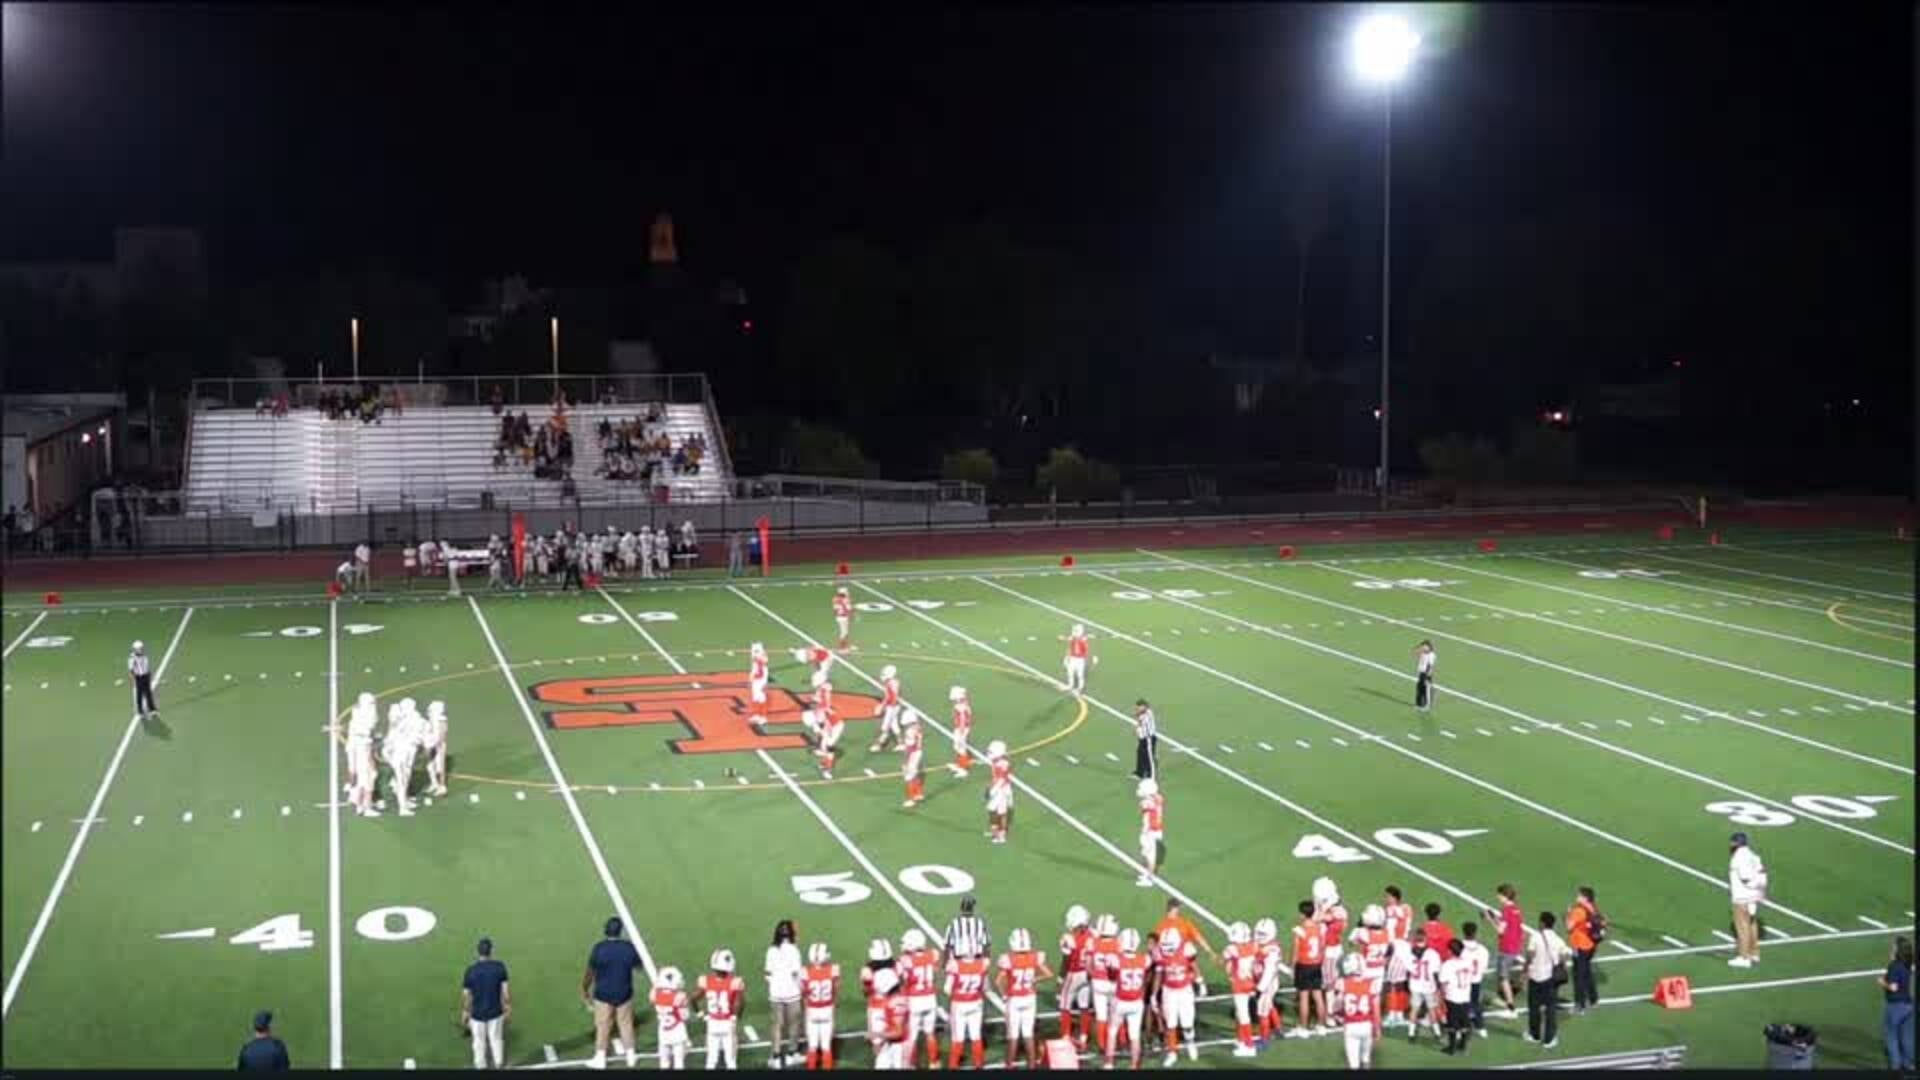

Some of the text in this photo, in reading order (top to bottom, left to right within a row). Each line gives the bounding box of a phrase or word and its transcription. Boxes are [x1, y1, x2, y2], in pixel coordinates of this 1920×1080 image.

[809, 979, 833, 1002] 32
[959, 974, 982, 995] 72
[1344, 993, 1371, 1016] 64
